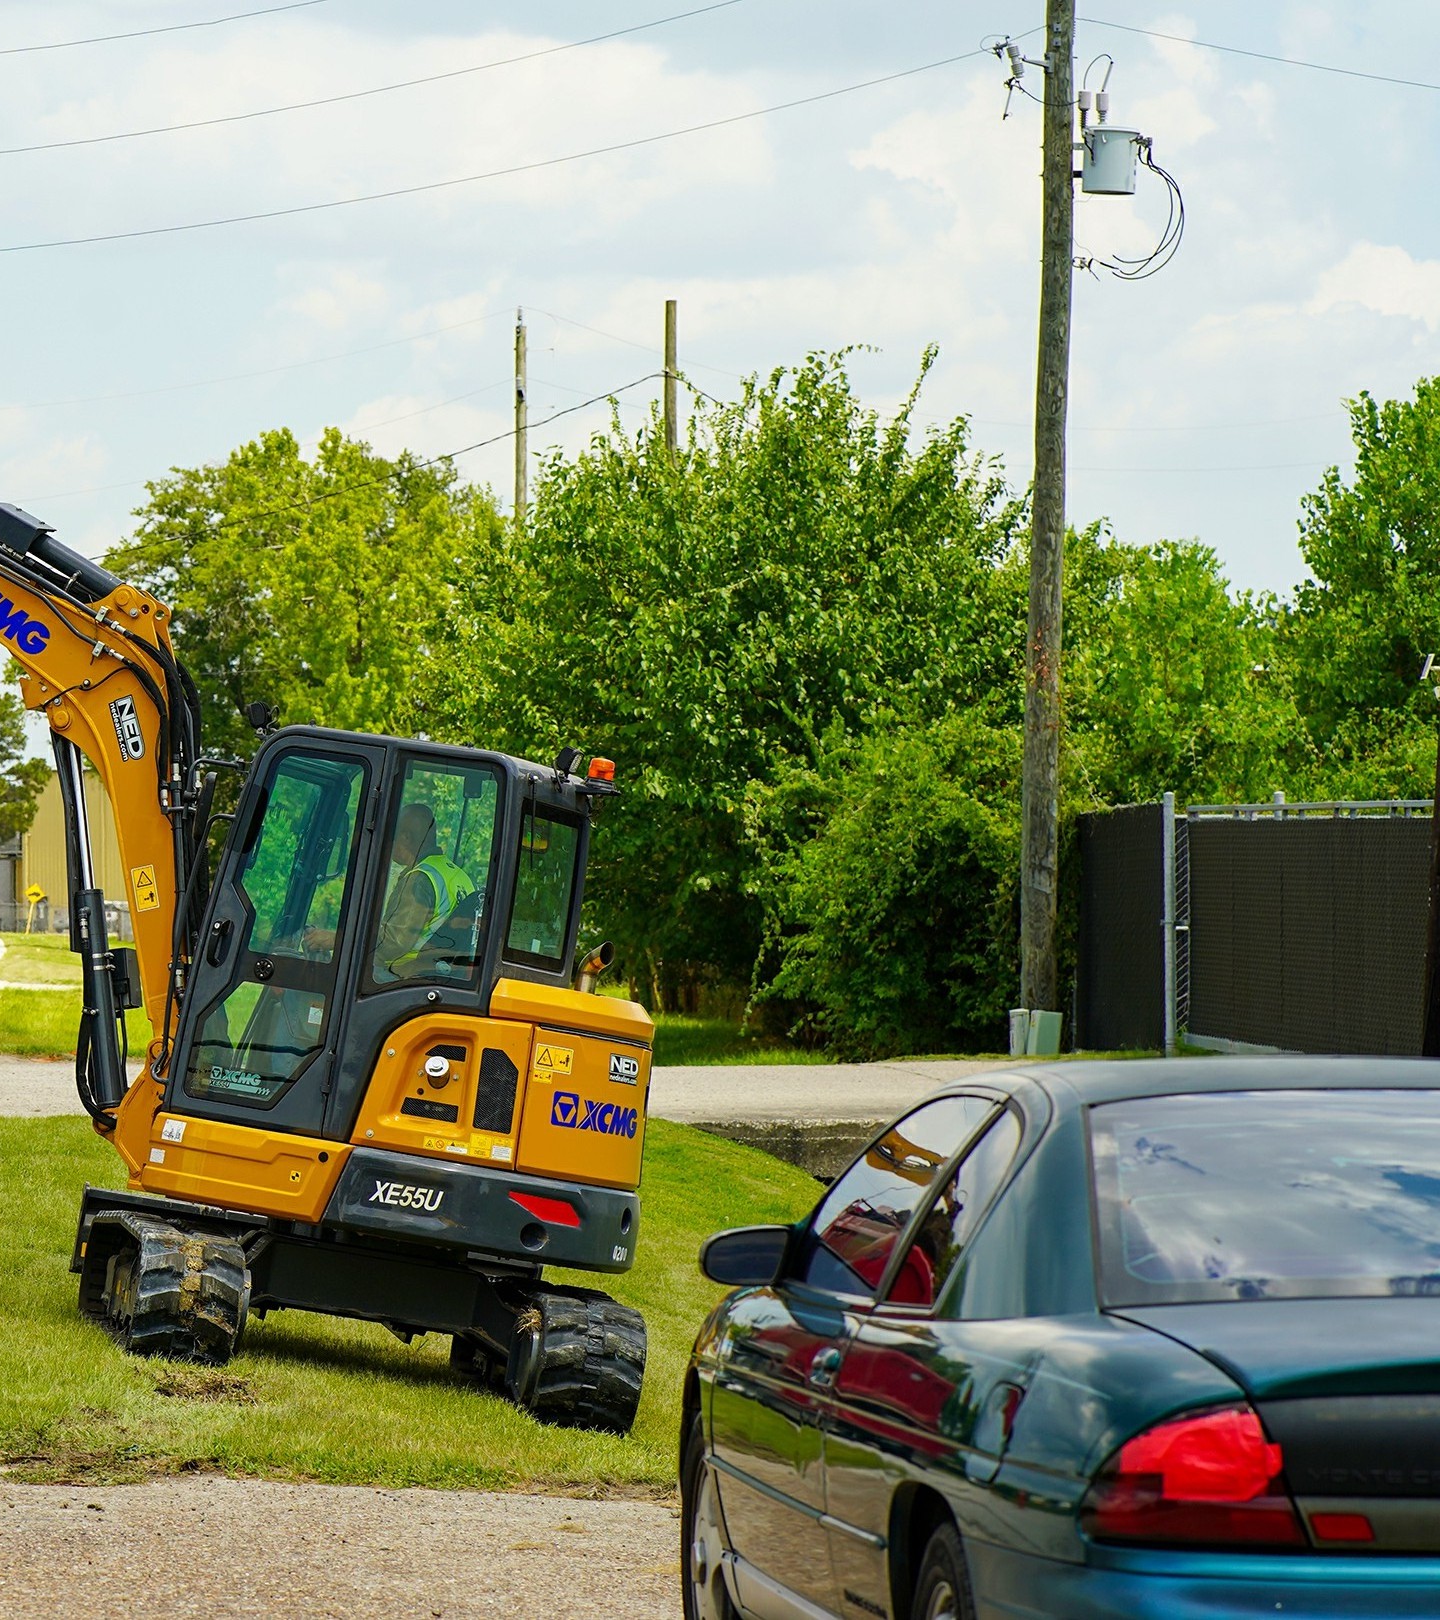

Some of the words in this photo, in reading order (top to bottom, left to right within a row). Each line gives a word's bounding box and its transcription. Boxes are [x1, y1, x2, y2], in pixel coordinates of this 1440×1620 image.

[109, 702, 129, 761] nedealers.com
[117, 697, 143, 758] NED
[222, 1069, 262, 1086] XCMG
[610, 1055, 639, 1077] NED
[576, 1099, 638, 1139] XCMG
[368, 1180, 445, 1212] XE55U
